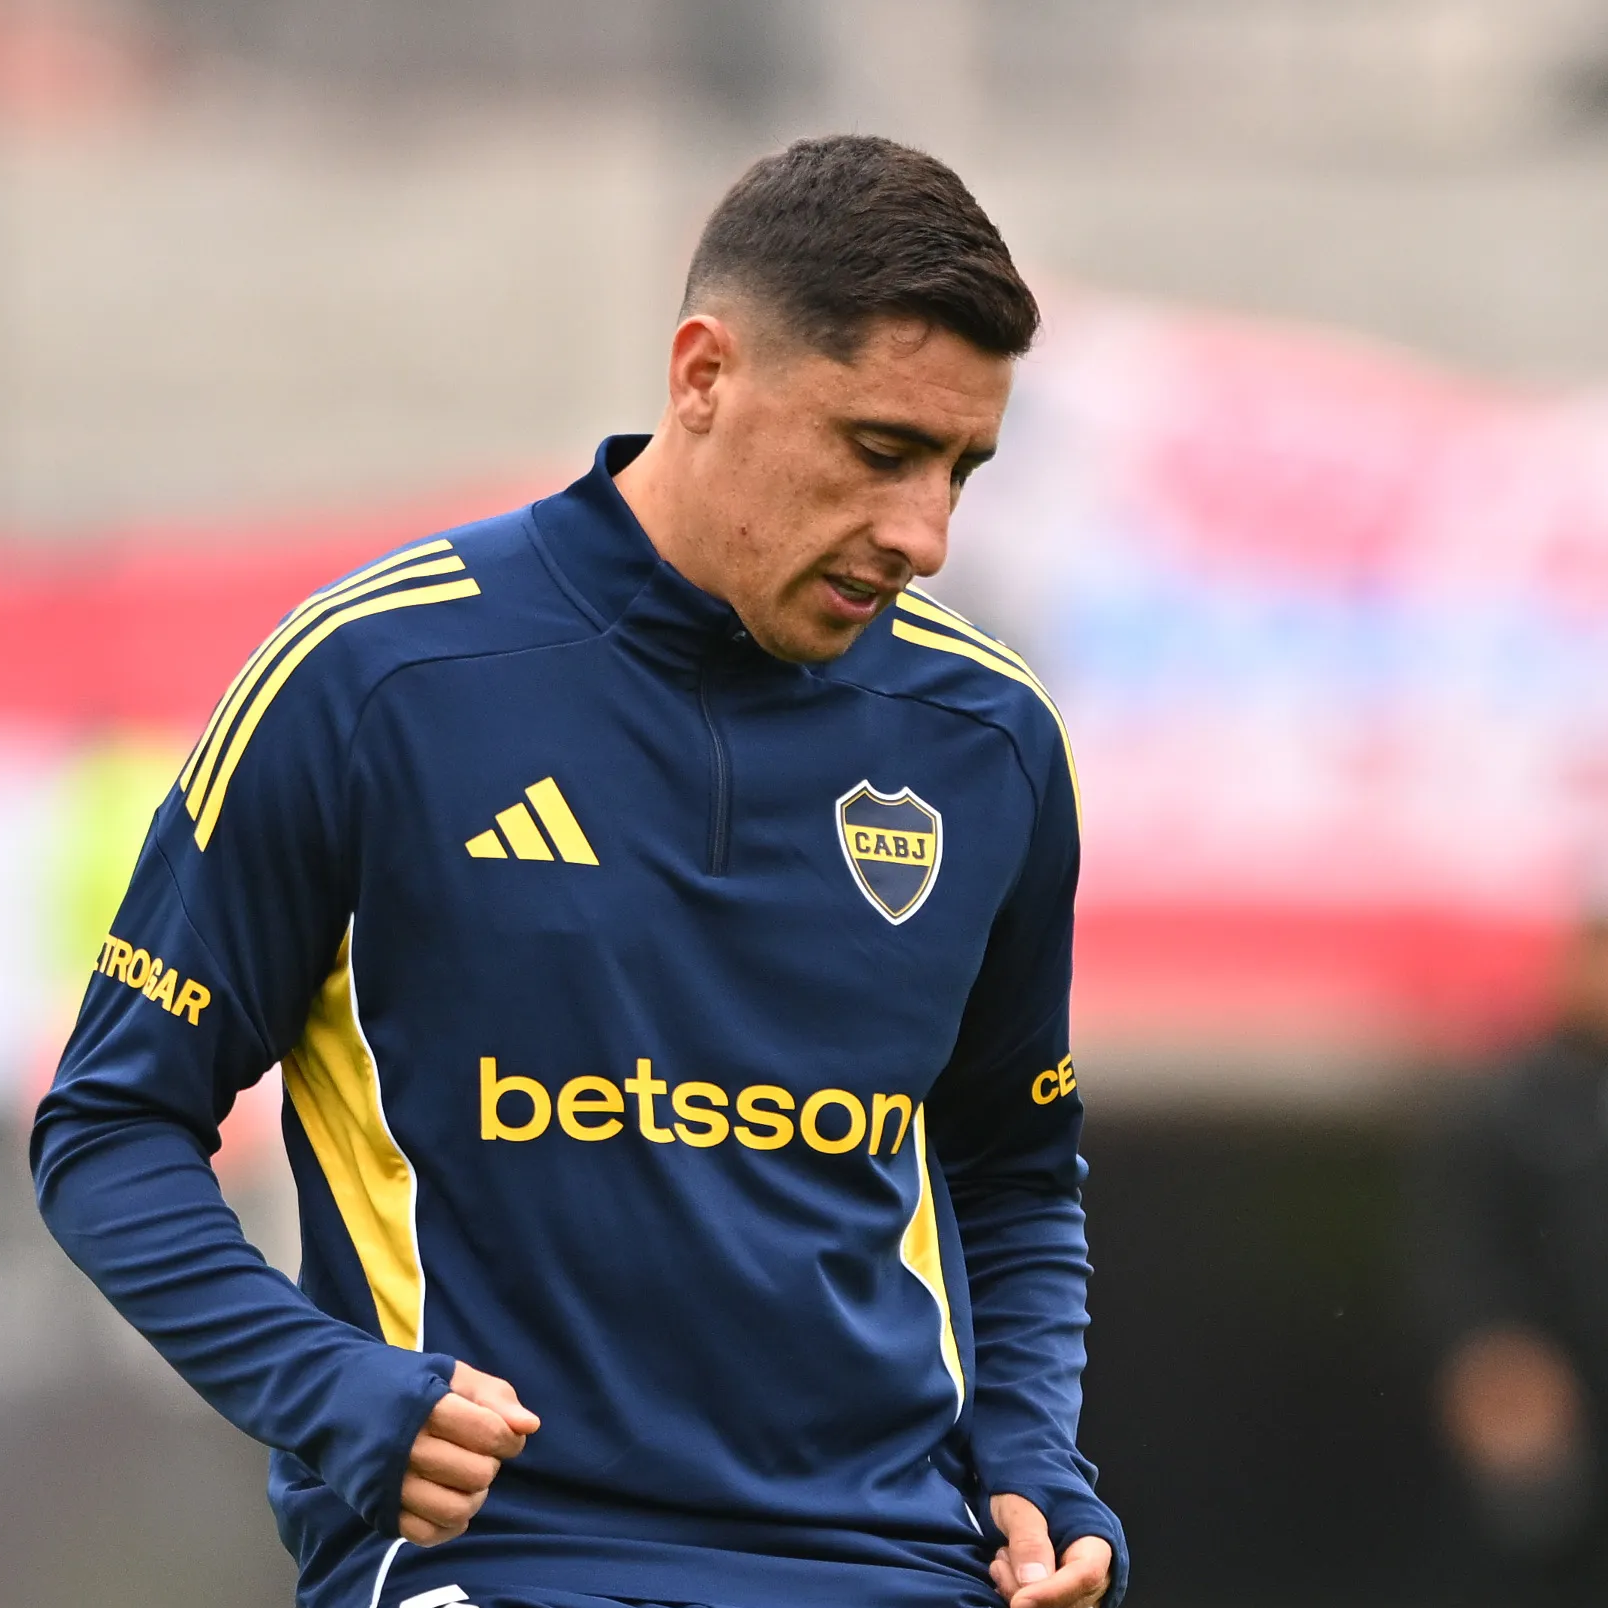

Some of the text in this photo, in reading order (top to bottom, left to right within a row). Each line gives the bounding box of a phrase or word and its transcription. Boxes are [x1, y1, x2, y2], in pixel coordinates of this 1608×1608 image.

[854, 831, 926, 860] CABJ
[94, 933, 212, 1027] TROGAR
[479, 1056, 913, 1157] betsson
